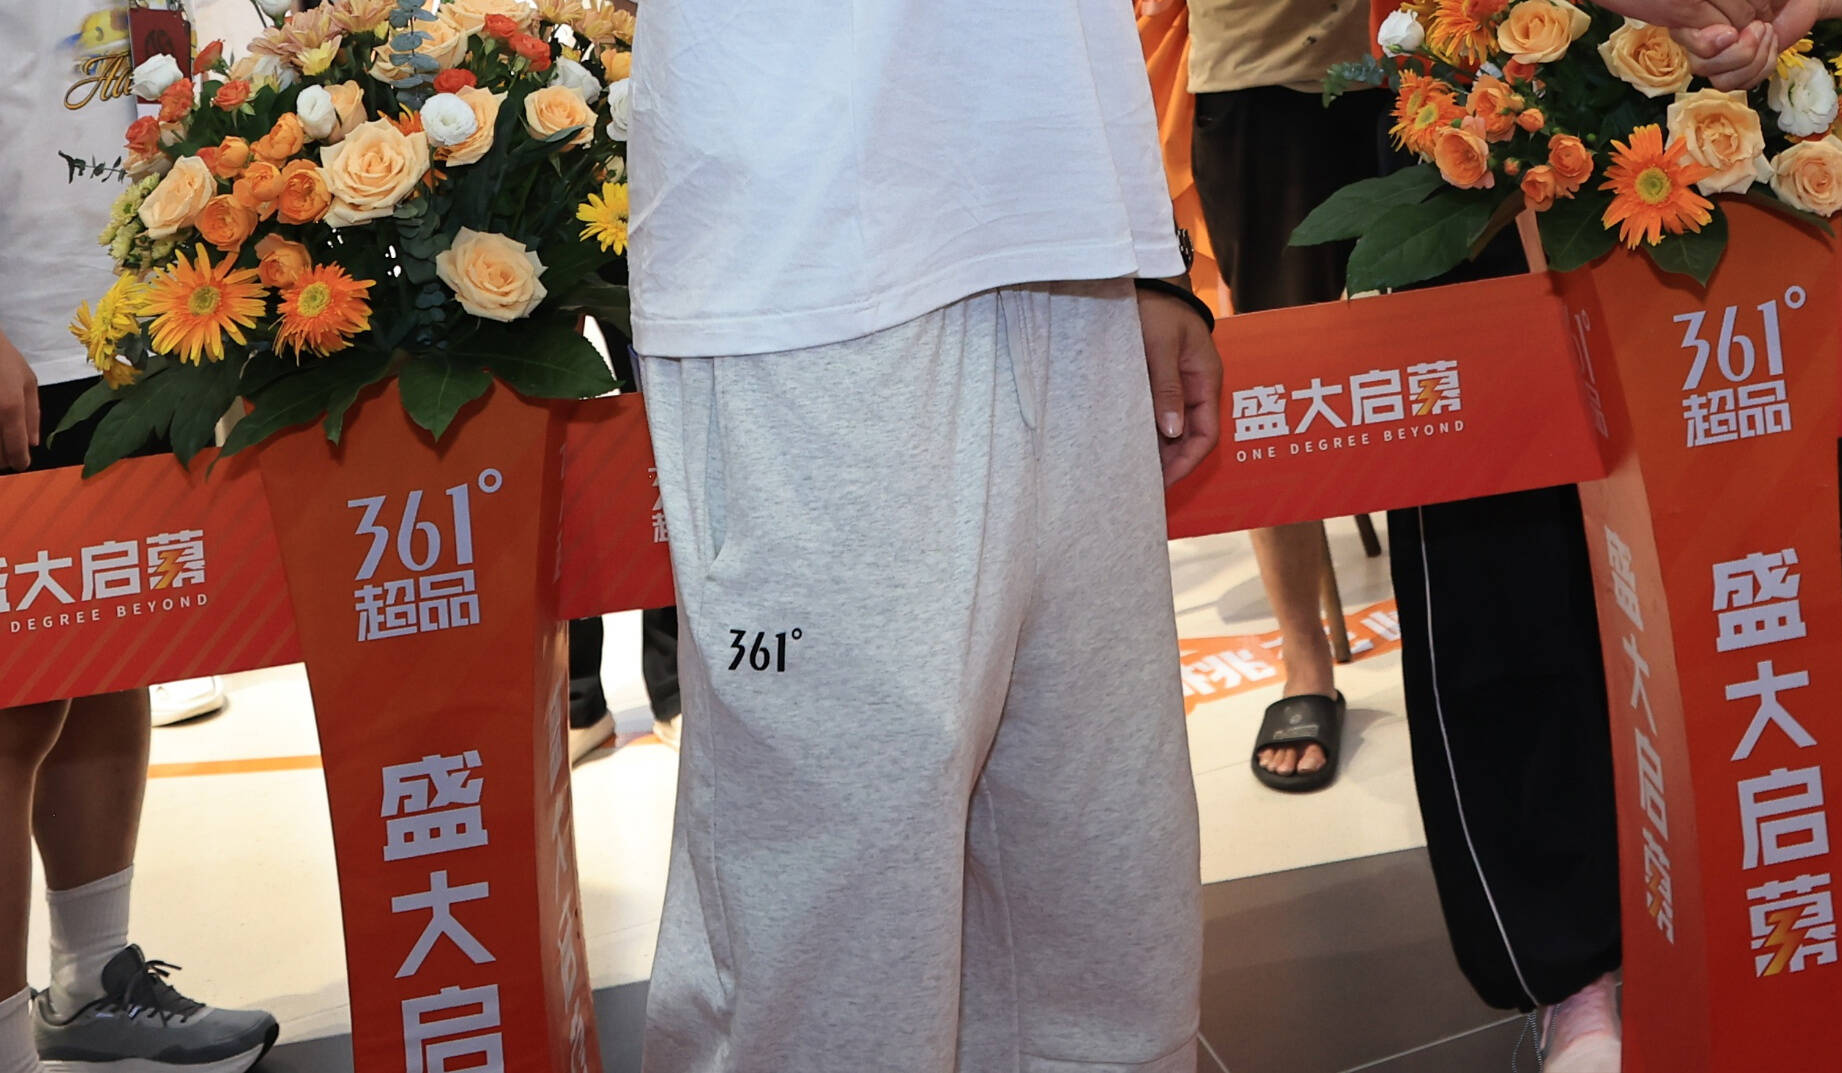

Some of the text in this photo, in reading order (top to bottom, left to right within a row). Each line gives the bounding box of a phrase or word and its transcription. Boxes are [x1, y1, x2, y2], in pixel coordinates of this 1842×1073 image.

[1673, 284, 1807, 392] 361°
[1235, 419, 1465, 463] ONE DEGREE BEYOND
[1682, 379, 1793, 449] 超品
[347, 467, 504, 582] 361°
[0, 529, 206, 614] 大启幕
[353, 568, 482, 643] 超品
[10, 592, 209, 634] DEGREE BEYOND
[727, 627, 803, 673] 361°
